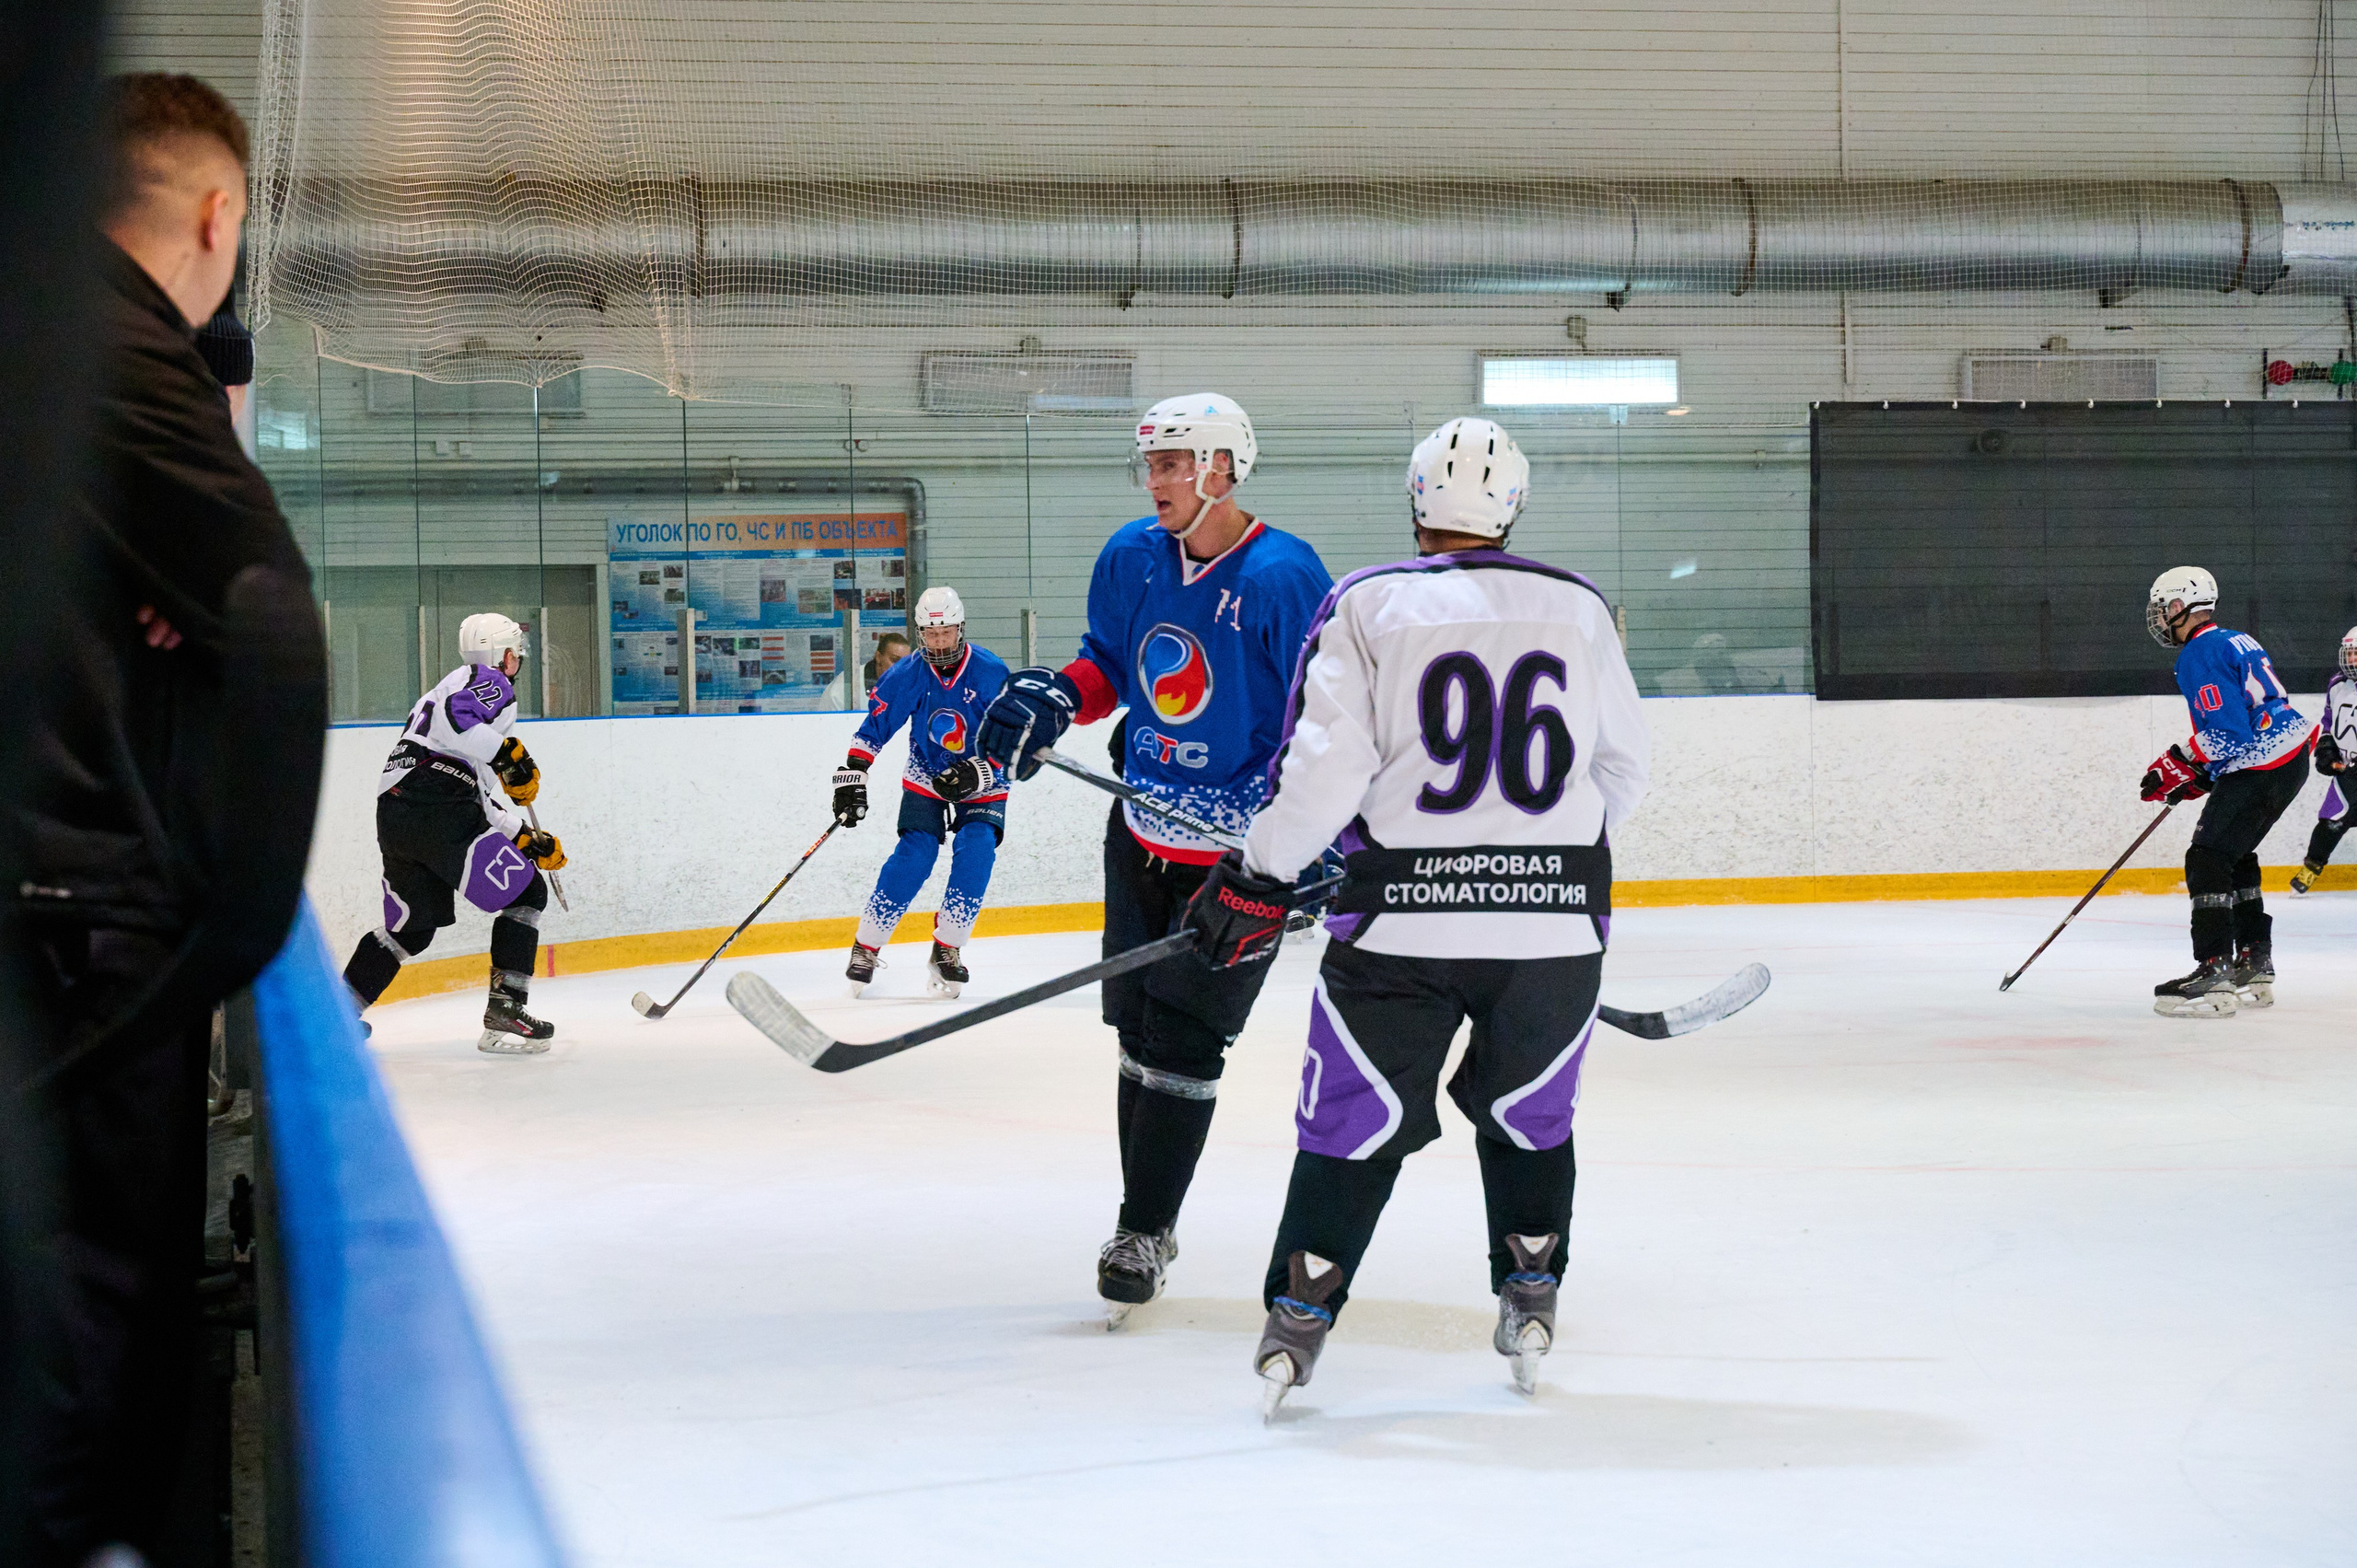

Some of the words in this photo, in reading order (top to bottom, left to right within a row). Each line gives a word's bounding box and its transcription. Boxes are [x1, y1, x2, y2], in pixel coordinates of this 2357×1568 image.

[616, 523, 683, 543] УГОЛОК
[687, 522, 711, 542] ПО
[716, 522, 742, 543] ГО,
[747, 521, 770, 540] ЧС
[774, 522, 785, 540] И
[791, 521, 814, 540] ПБ
[819, 520, 899, 540] ОБЪЕКТА
[468, 679, 503, 711] 22
[1415, 650, 1575, 815] 96
[1133, 726, 1209, 769] АТС
[430, 761, 477, 788] BAUER
[1132, 793, 1173, 813] ACE
[1413, 854, 1562, 878] ЦИФРОВАЯ
[1217, 886, 1287, 920] Reebok
[1384, 882, 1587, 905] СТОМАТОЛОГИЯ
